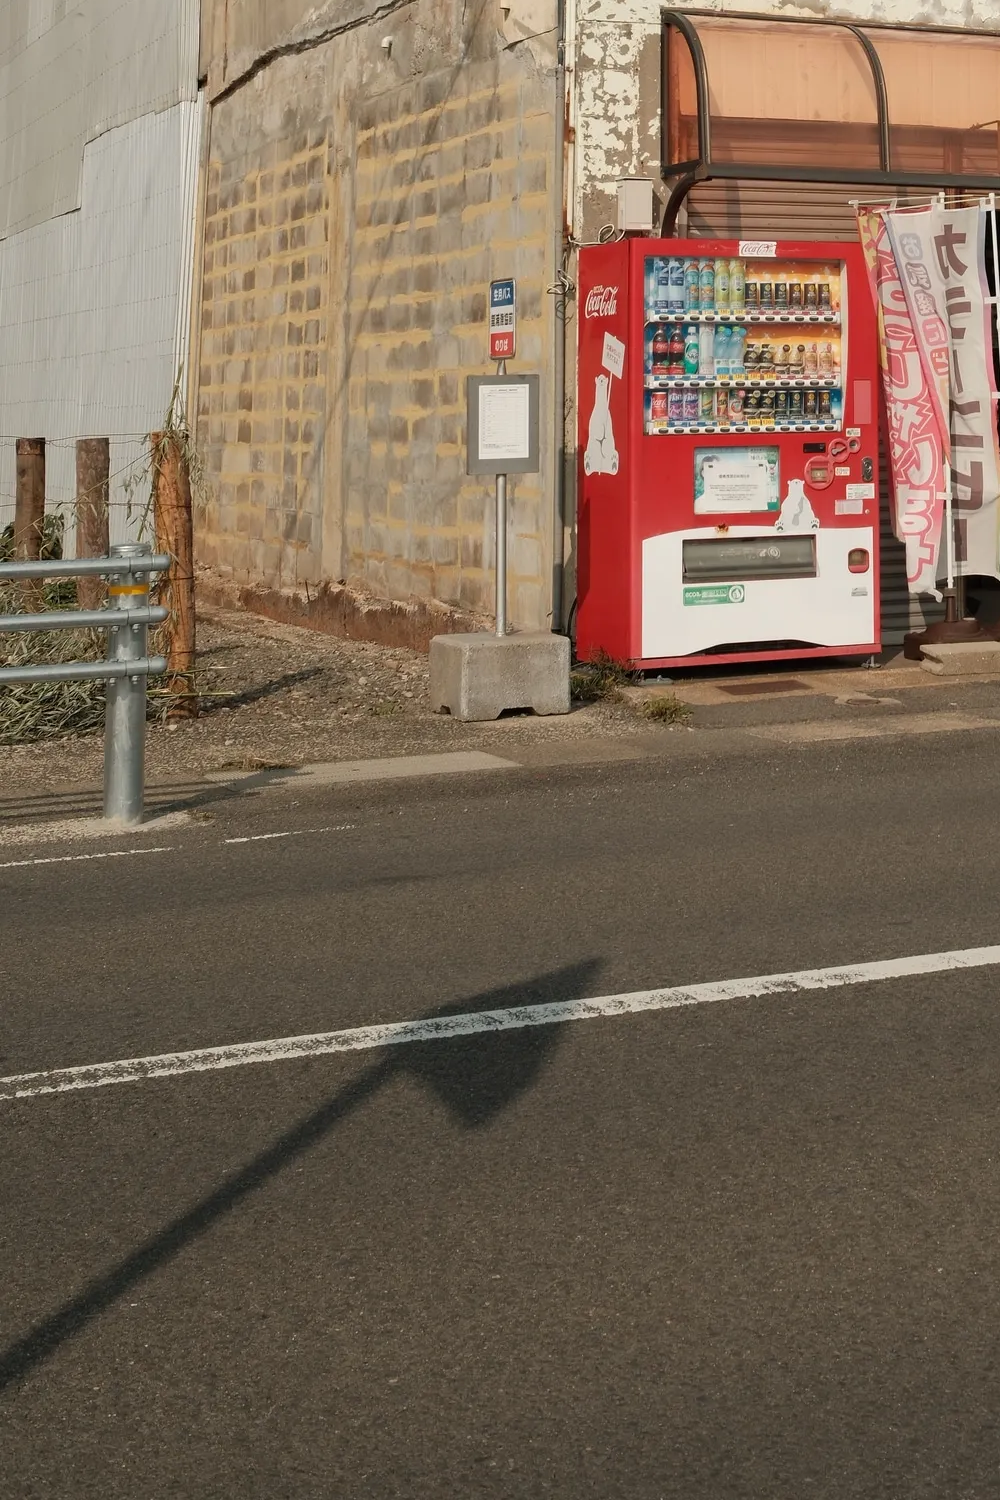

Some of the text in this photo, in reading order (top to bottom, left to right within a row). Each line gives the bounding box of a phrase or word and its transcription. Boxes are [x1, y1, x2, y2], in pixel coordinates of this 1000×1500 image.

[585, 286, 619, 319] Coca-Cola
[494, 338, 509, 352] のりば
